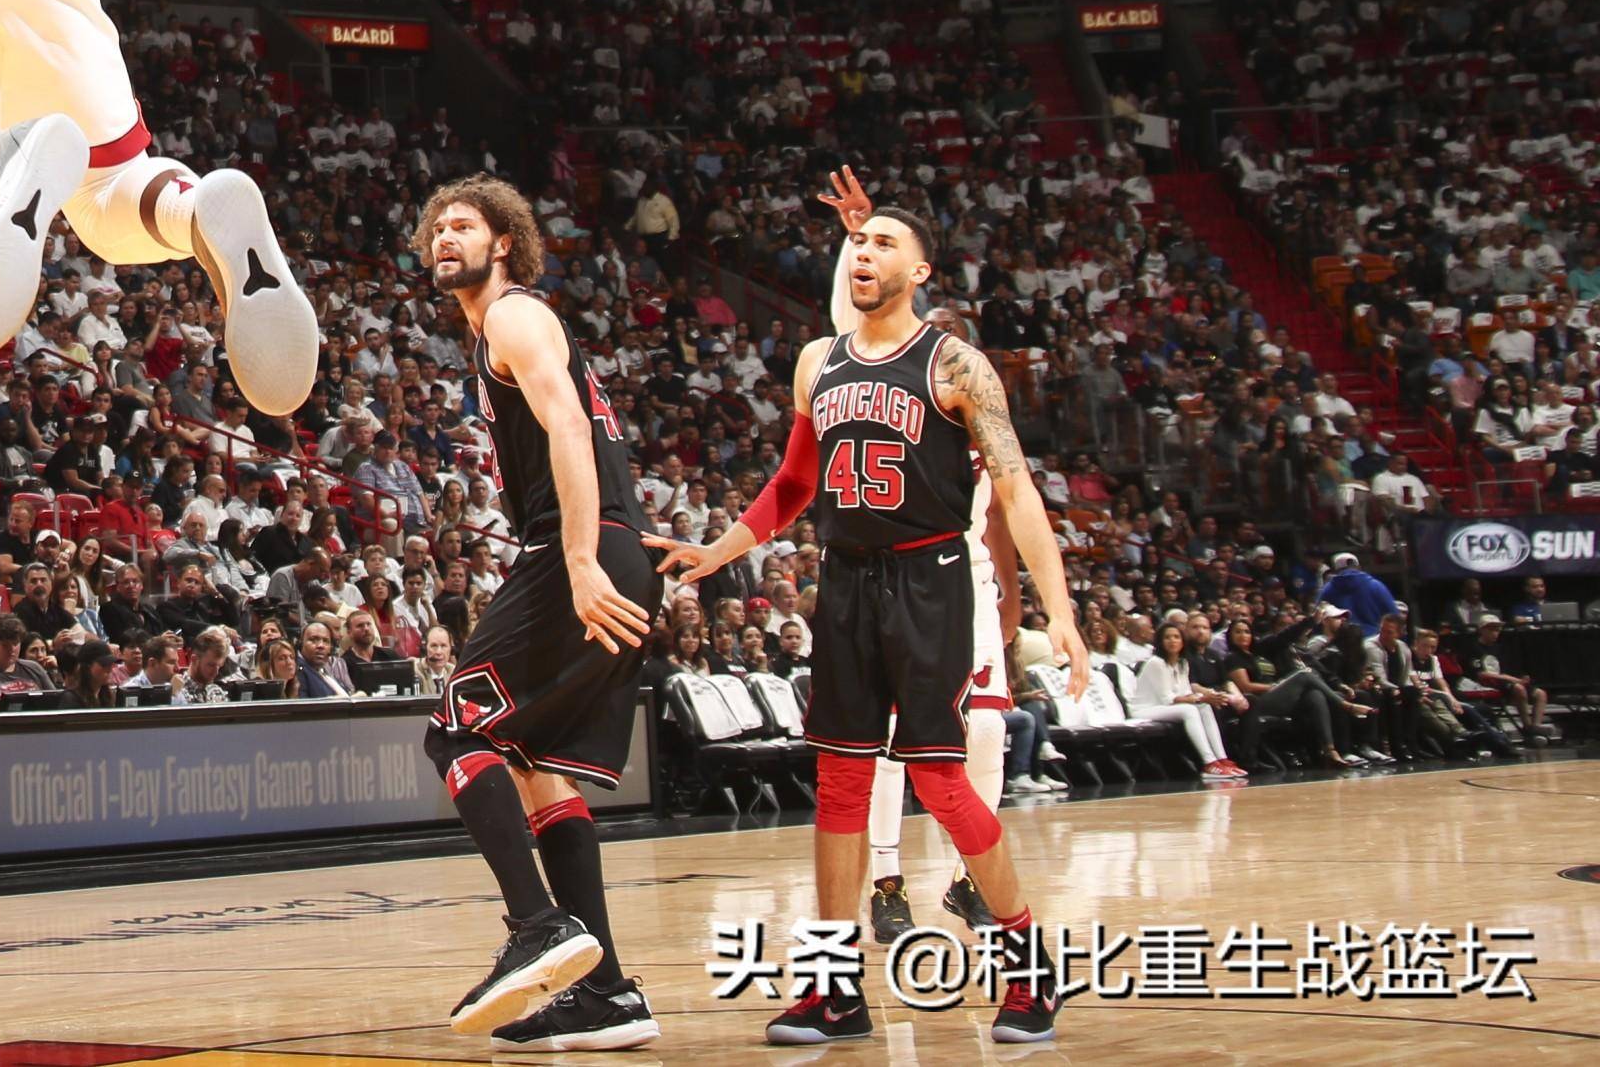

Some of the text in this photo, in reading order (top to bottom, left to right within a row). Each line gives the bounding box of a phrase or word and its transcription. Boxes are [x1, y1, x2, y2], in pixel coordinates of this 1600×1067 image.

[332, 25, 395, 45] BACARDÍ
[1081, 4, 1160, 30] BACARDÍ
[811, 380, 925, 444] CHICAGO
[825, 441, 904, 510] 45
[1467, 531, 1595, 560] FOX SUN
[11, 760, 94, 826] Official
[98, 758, 160, 827] 1-Day
[165, 756, 250, 821] Fantasy
[255, 751, 313, 809] Game
[318, 747, 339, 805] of
[341, 746, 375, 804] the
[379, 742, 419, 801] NBA
